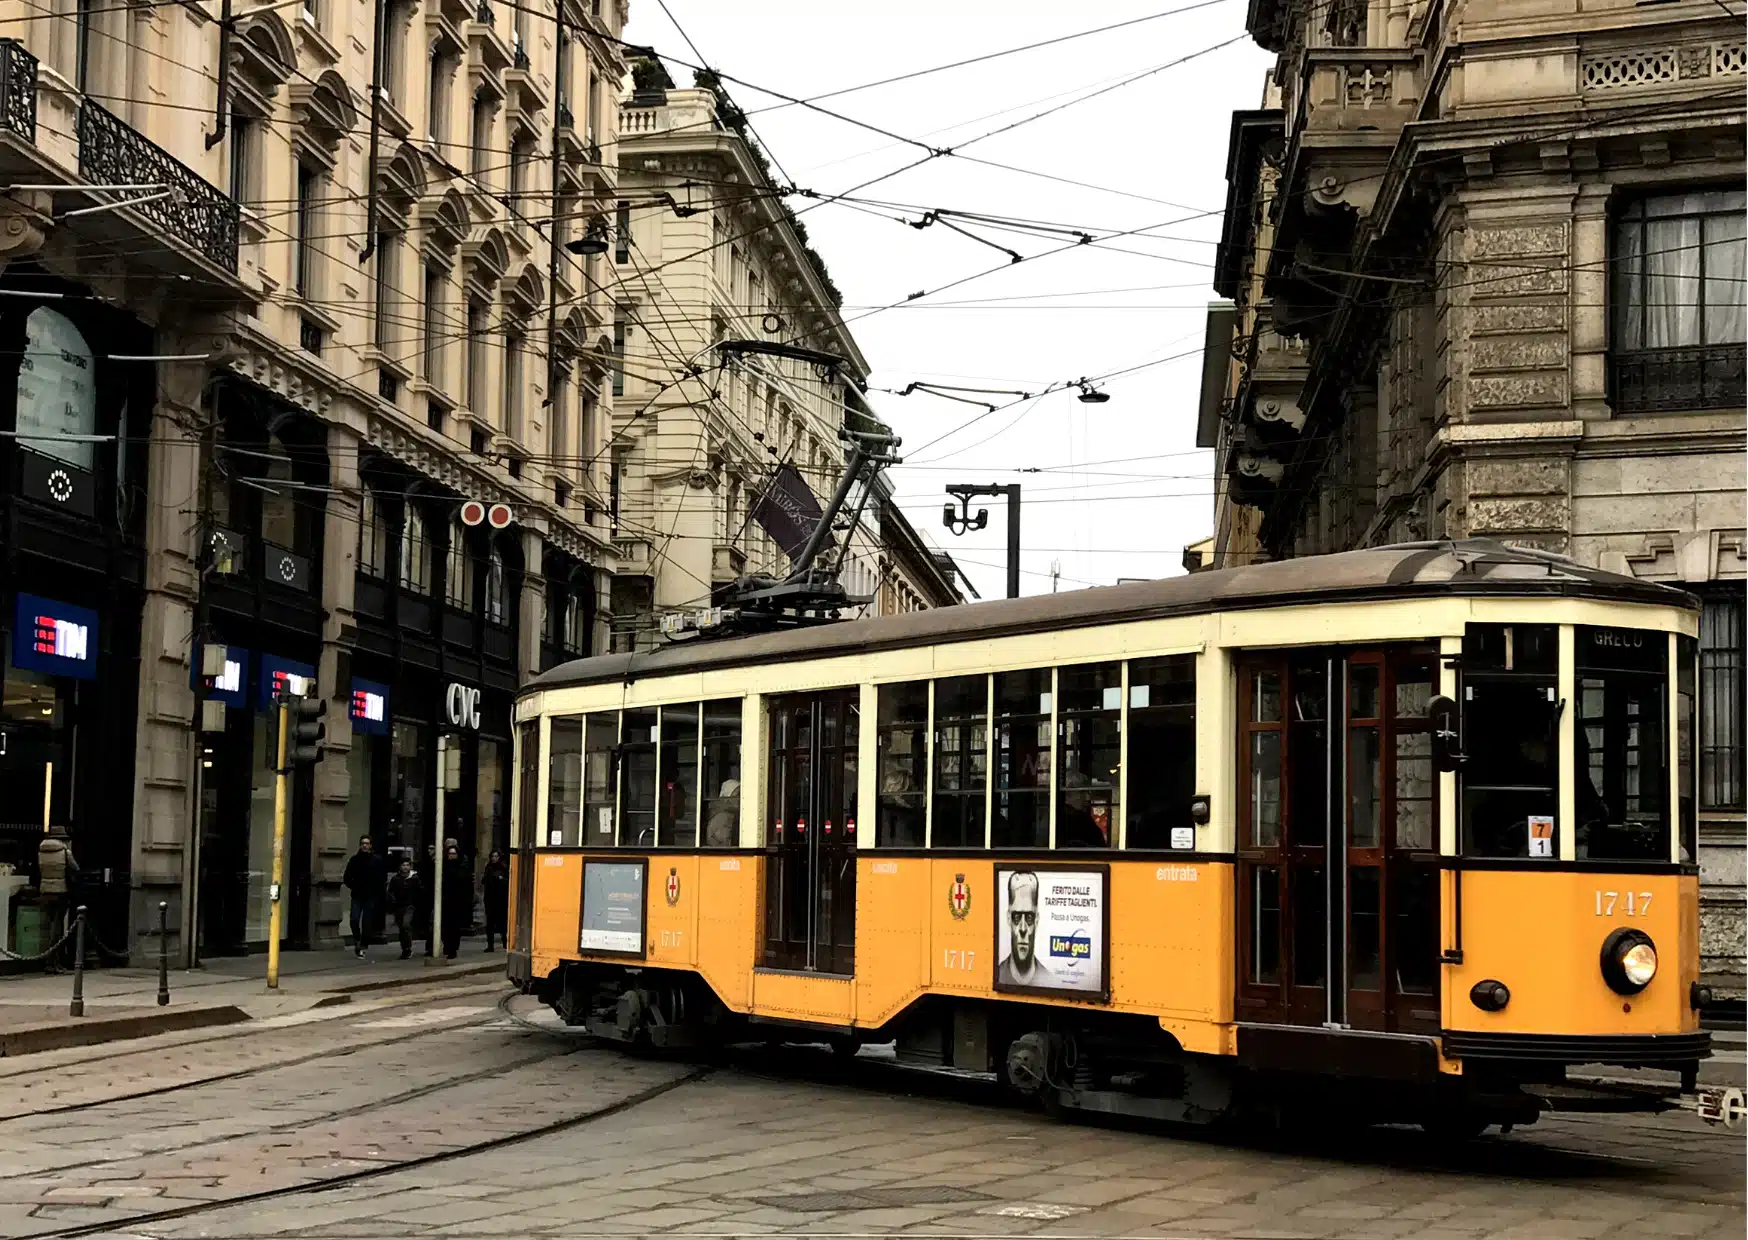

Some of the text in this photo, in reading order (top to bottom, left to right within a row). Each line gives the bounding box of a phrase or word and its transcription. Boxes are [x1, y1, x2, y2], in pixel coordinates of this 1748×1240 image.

[1503, 627, 1513, 670] 1
[1536, 823, 1545, 838] 7
[1537, 840, 1544, 854] 1
[1157, 865, 1197, 881] entrata
[1072, 886, 1090, 896] DALLE
[1045, 897, 1067, 907] TARIFFE
[1595, 890, 1653, 917] 1747
